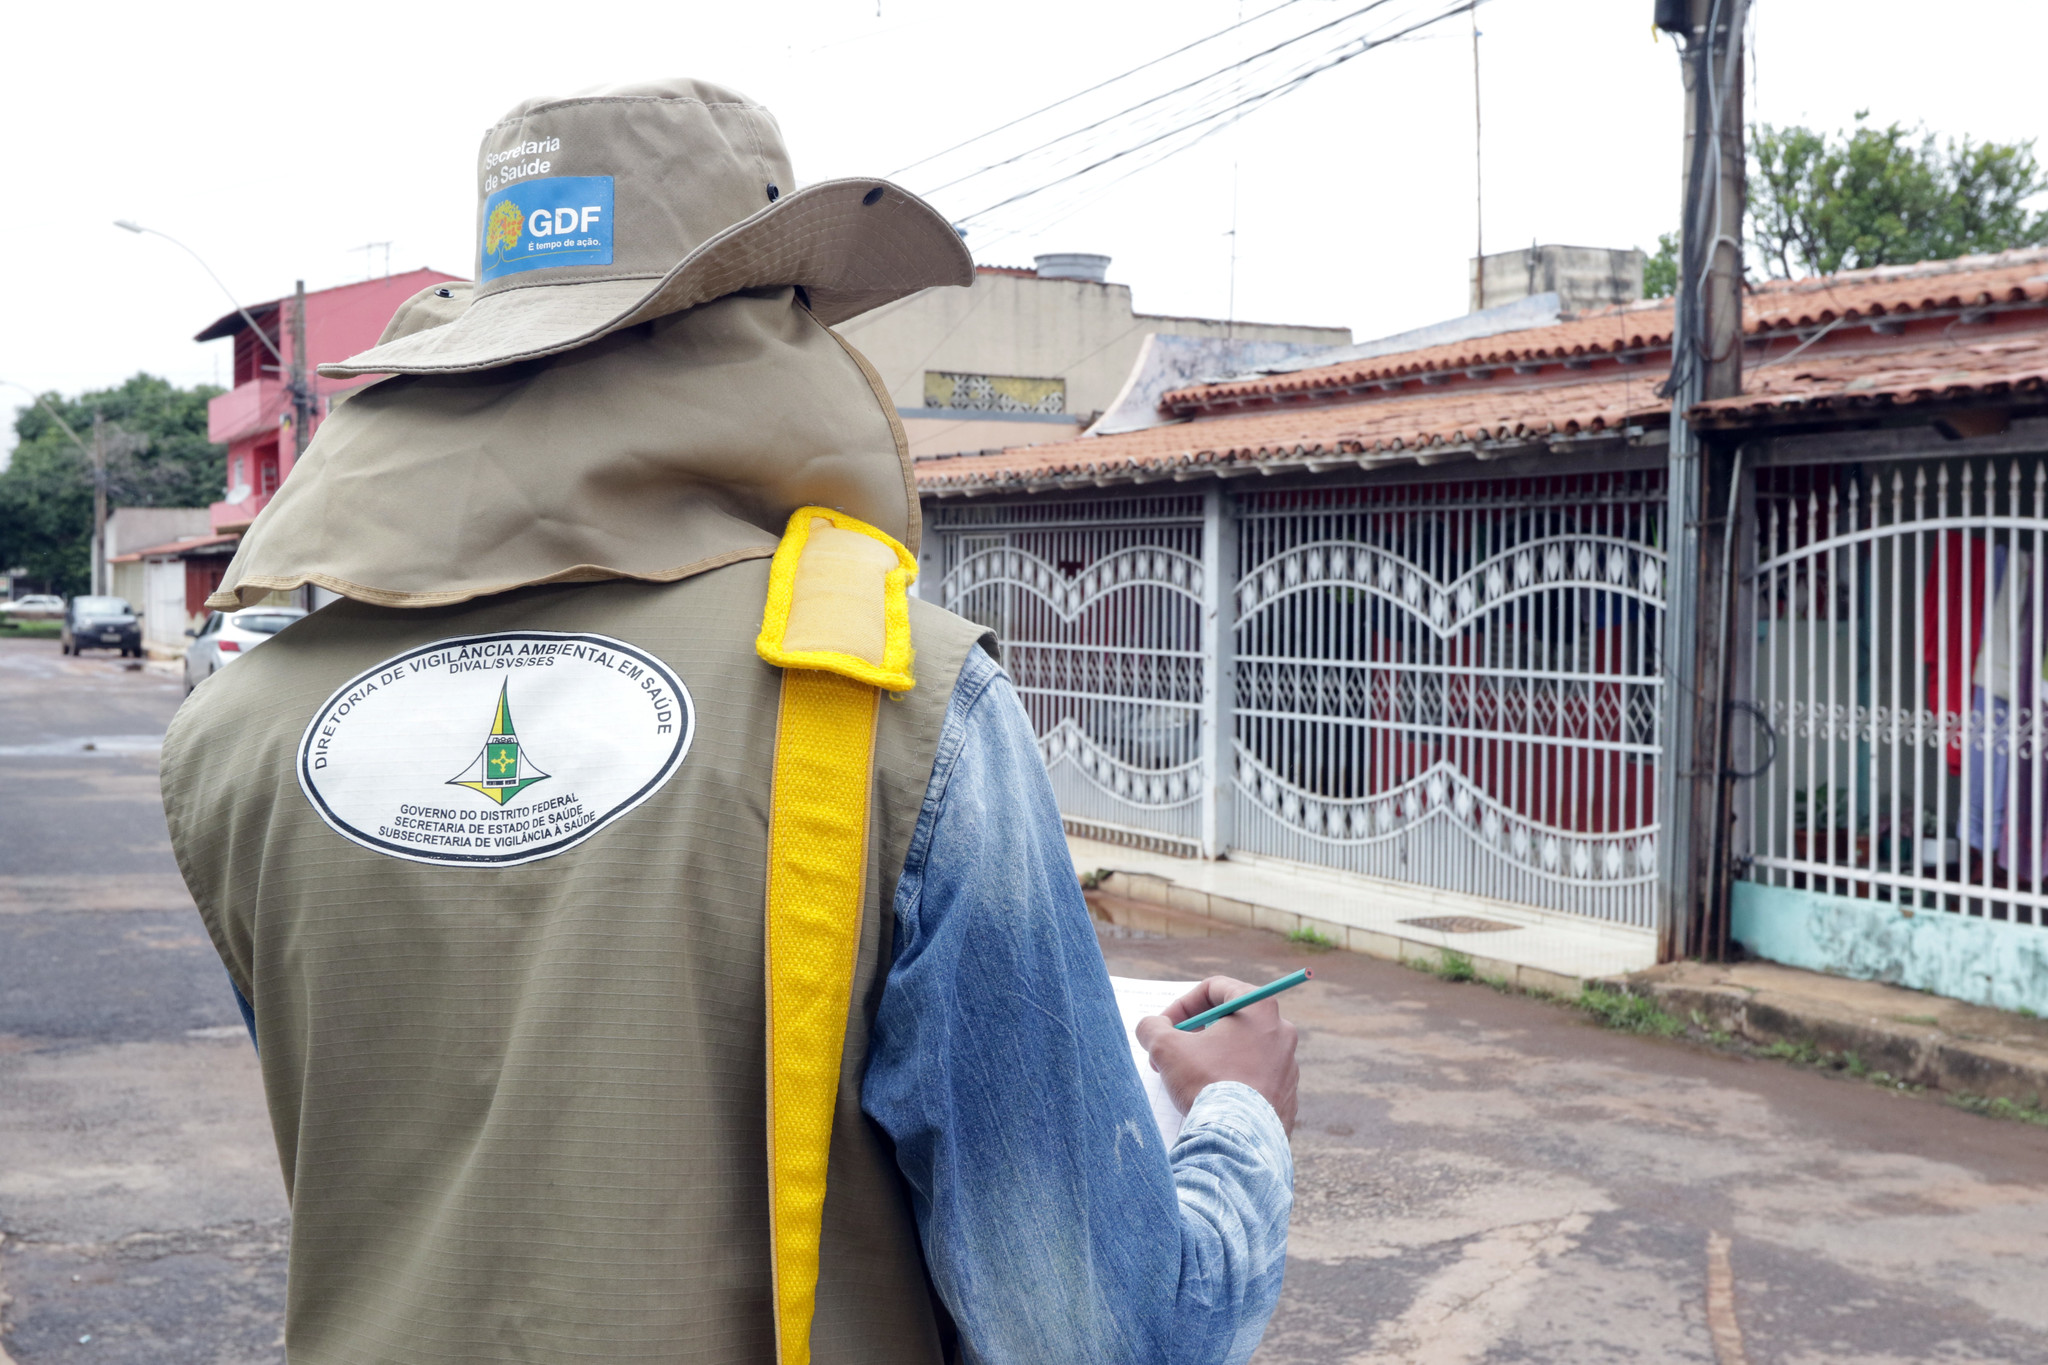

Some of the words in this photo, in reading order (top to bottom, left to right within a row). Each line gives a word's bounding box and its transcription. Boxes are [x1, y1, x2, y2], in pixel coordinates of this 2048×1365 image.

[486, 136, 560, 170] Secretaria
[485, 175, 498, 192] de
[500, 158, 551, 184] Saúde
[528, 206, 601, 237] GDF
[528, 241, 534, 251] É
[536, 241, 562, 250] tempo
[563, 238, 575, 247] de
[577, 237, 601, 247] ação.
[449, 656, 555, 674] DIVAL/SVS/SES
[315, 682, 378, 770] DIRETORIA
[380, 666, 405, 686] DE
[410, 643, 513, 673] VIGILÂNCIA
[518, 643, 615, 669] AMBIENTAL
[617, 659, 644, 681] EM
[641, 677, 673, 735] SAÚDE
[394, 816, 465, 834] SECRETARIA
[468, 823, 485, 834] DE
[488, 820, 530, 834] ESTADO
[532, 816, 545, 828] DE
[548, 804, 583, 824] SAÚDE
[400, 804, 457, 820] GOVERNO
[460, 810, 477, 821] DO
[481, 806, 530, 821] DISTRITO
[532, 792, 579, 814] FEDERAL
[378, 825, 472, 847] SUBSECRETARIA
[475, 837, 491, 847] DE
[494, 828, 552, 848] VIGILÂNCIA
[555, 823, 562, 836] À
[563, 810, 596, 832] SAÚDE
